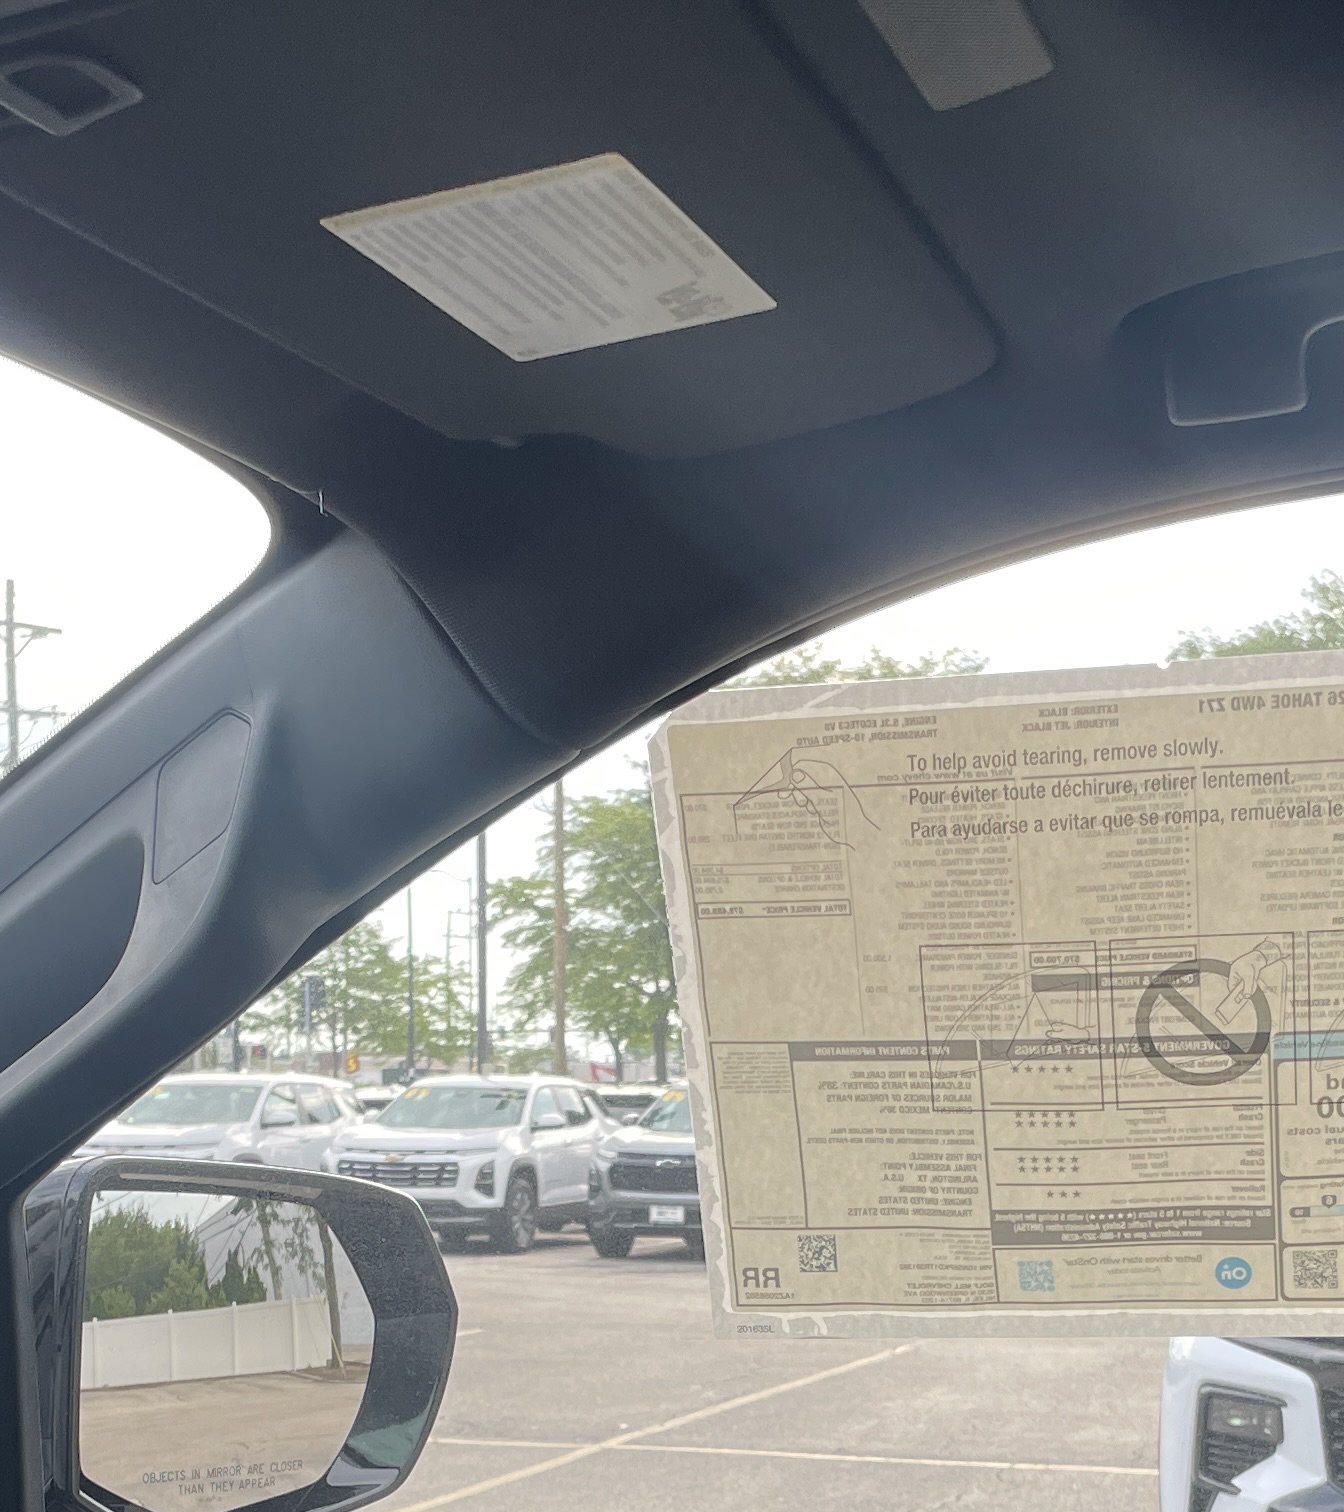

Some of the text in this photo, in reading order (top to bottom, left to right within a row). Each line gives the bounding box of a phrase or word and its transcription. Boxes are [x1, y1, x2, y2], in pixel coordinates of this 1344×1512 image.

[907, 738, 1223, 773] To help avoid tearing, remove slowly.
[910, 768, 1294, 805] Pour éviter toute déchirure, retirer lentement.
[911, 821, 946, 838] Para
[953, 818, 1028, 840] ayudarse
[1035, 819, 1044, 832] a
[1050, 814, 1097, 831] evitar
[1102, 812, 1134, 832] que
[1139, 811, 1158, 825] se
[1163, 810, 1225, 826] rompa,
[1231, 802, 1321, 821] remuévala
[143, 1460, 303, 1484] OBJECTS IN MIRROR ARE CLOSER
[179, 1477, 275, 1495] THAN THEY APPEAR
